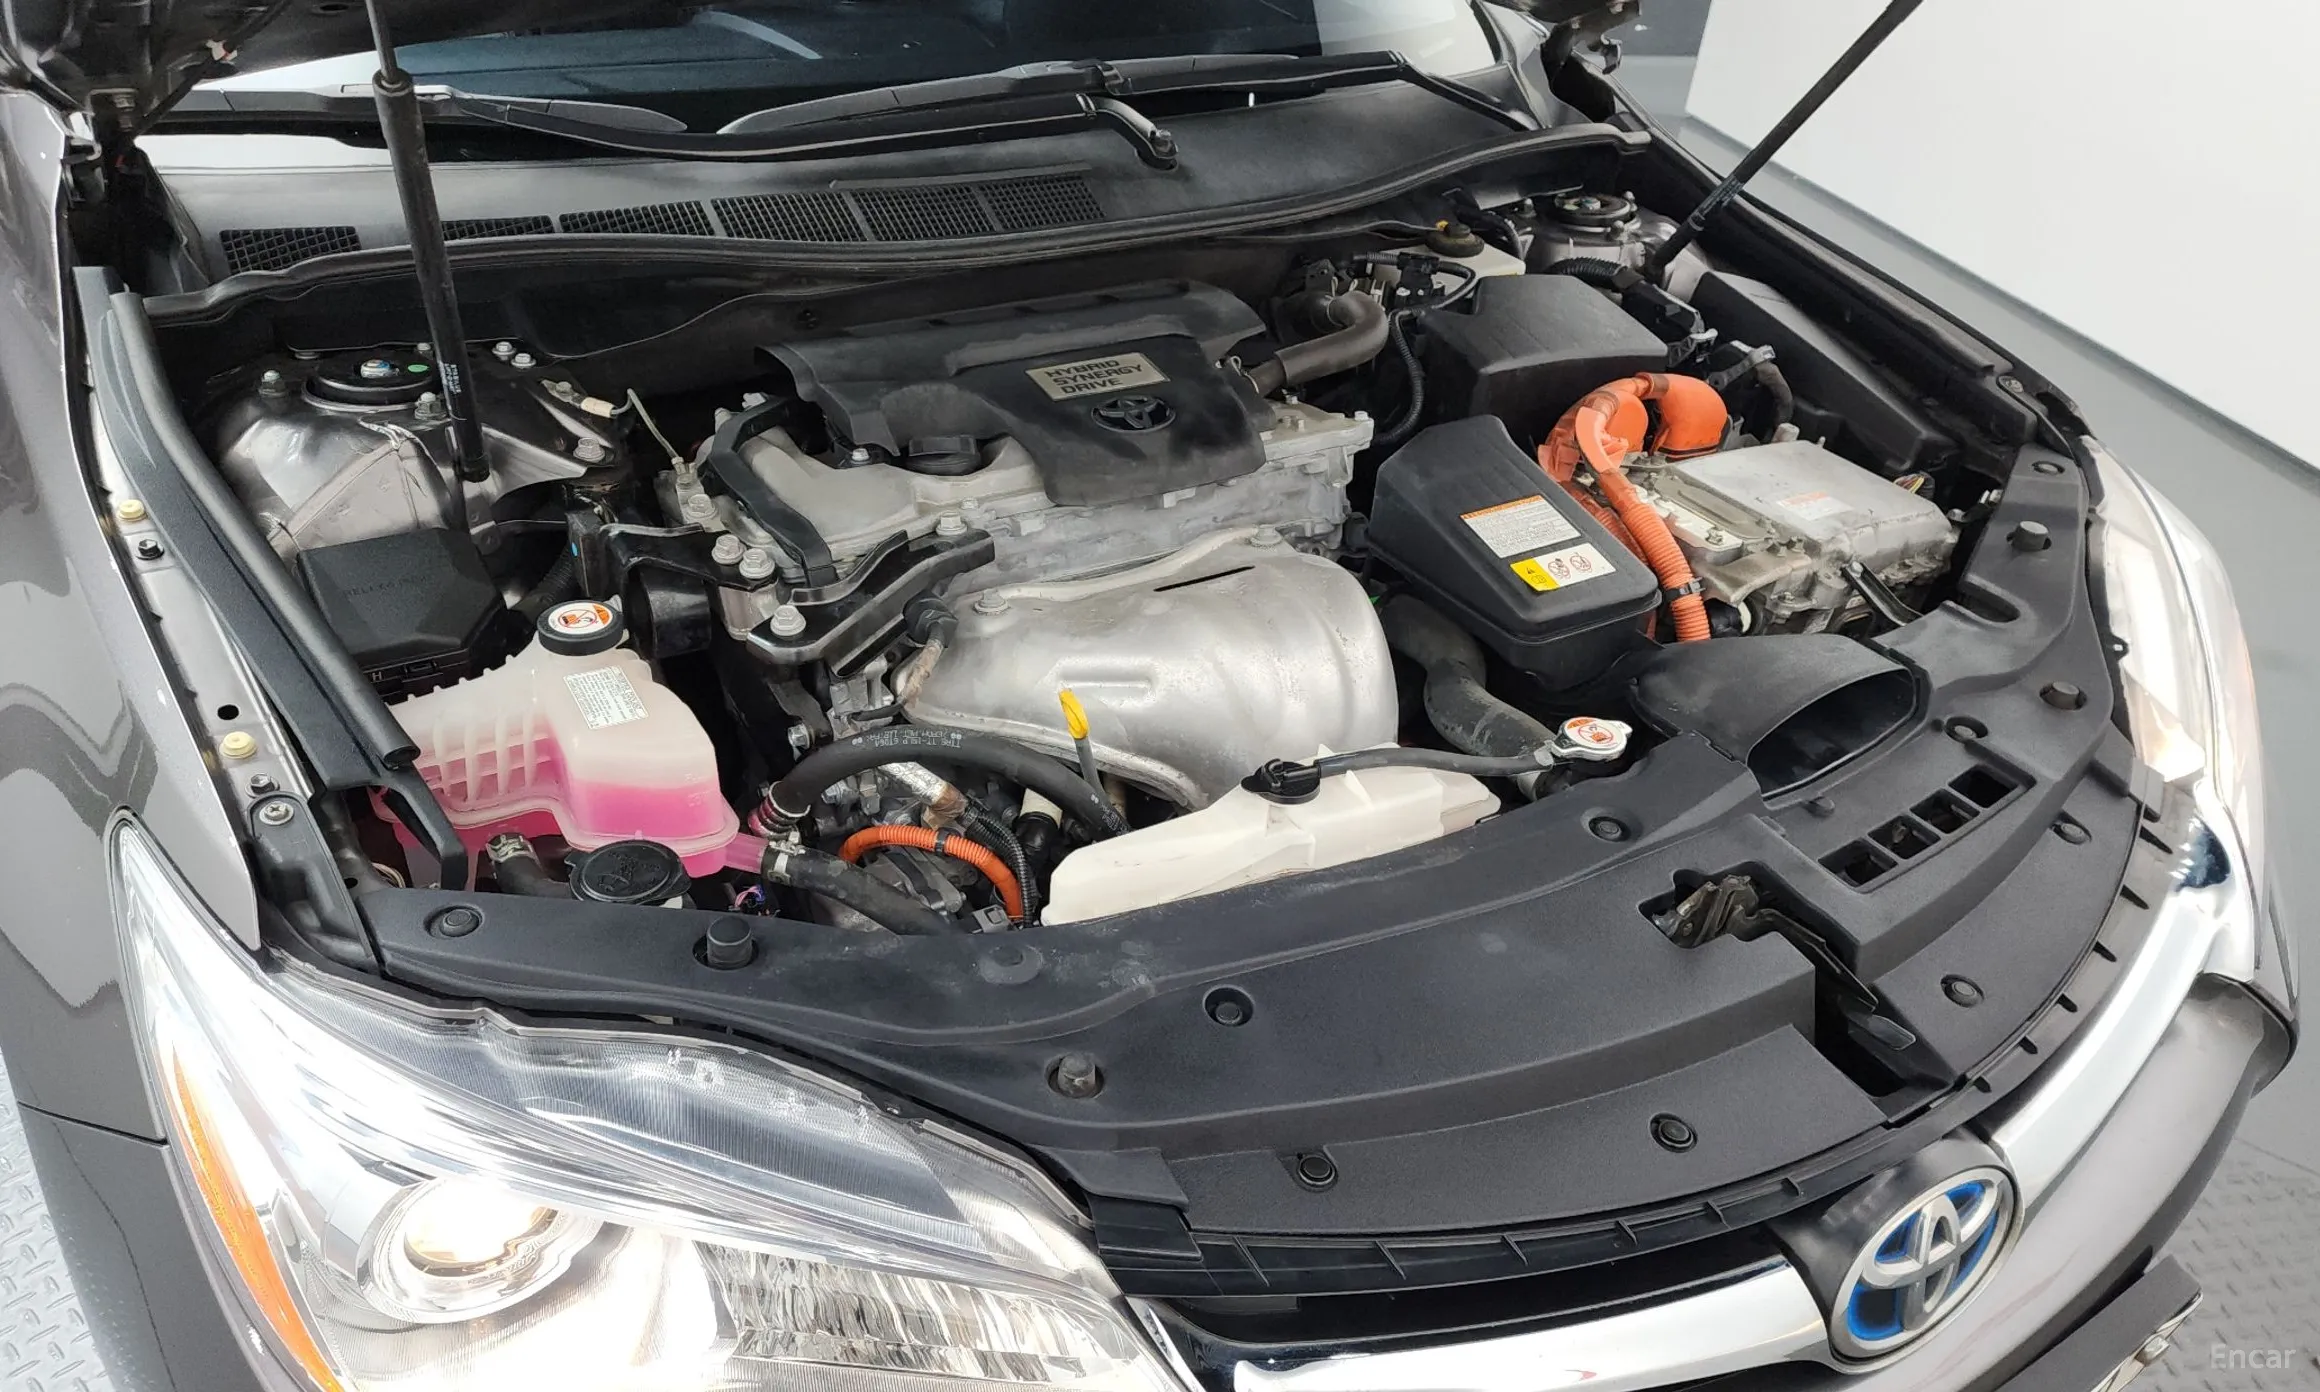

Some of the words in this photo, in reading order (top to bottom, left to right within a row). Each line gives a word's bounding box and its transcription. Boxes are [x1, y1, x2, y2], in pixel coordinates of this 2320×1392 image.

[1045, 360, 1120, 377] HYBRID
[1053, 364, 1142, 386] SYNERGY
[1061, 377, 1123, 394] DRIVE
